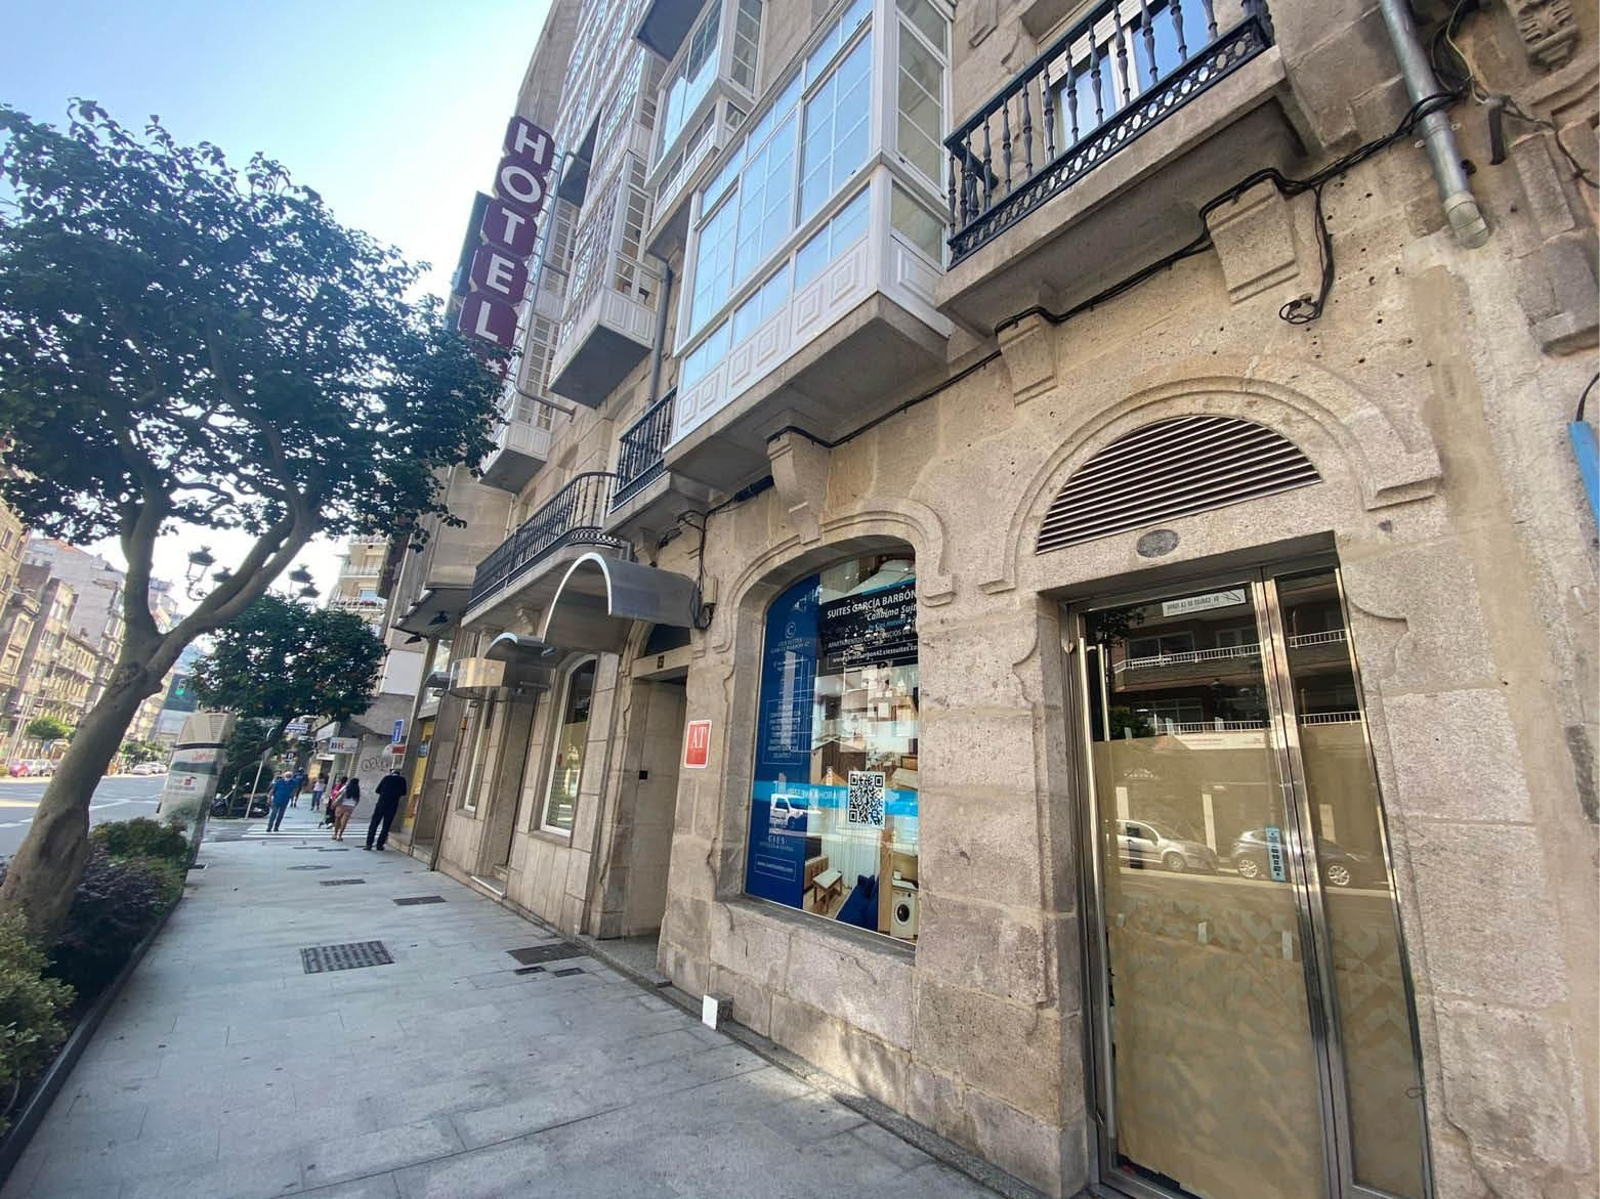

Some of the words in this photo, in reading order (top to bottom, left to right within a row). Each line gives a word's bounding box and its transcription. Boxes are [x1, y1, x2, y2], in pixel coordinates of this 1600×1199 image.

[474, 121, 547, 344] HOTEL
[827, 605, 851, 619] SUITES
[852, 597, 881, 612] GARCÍA
